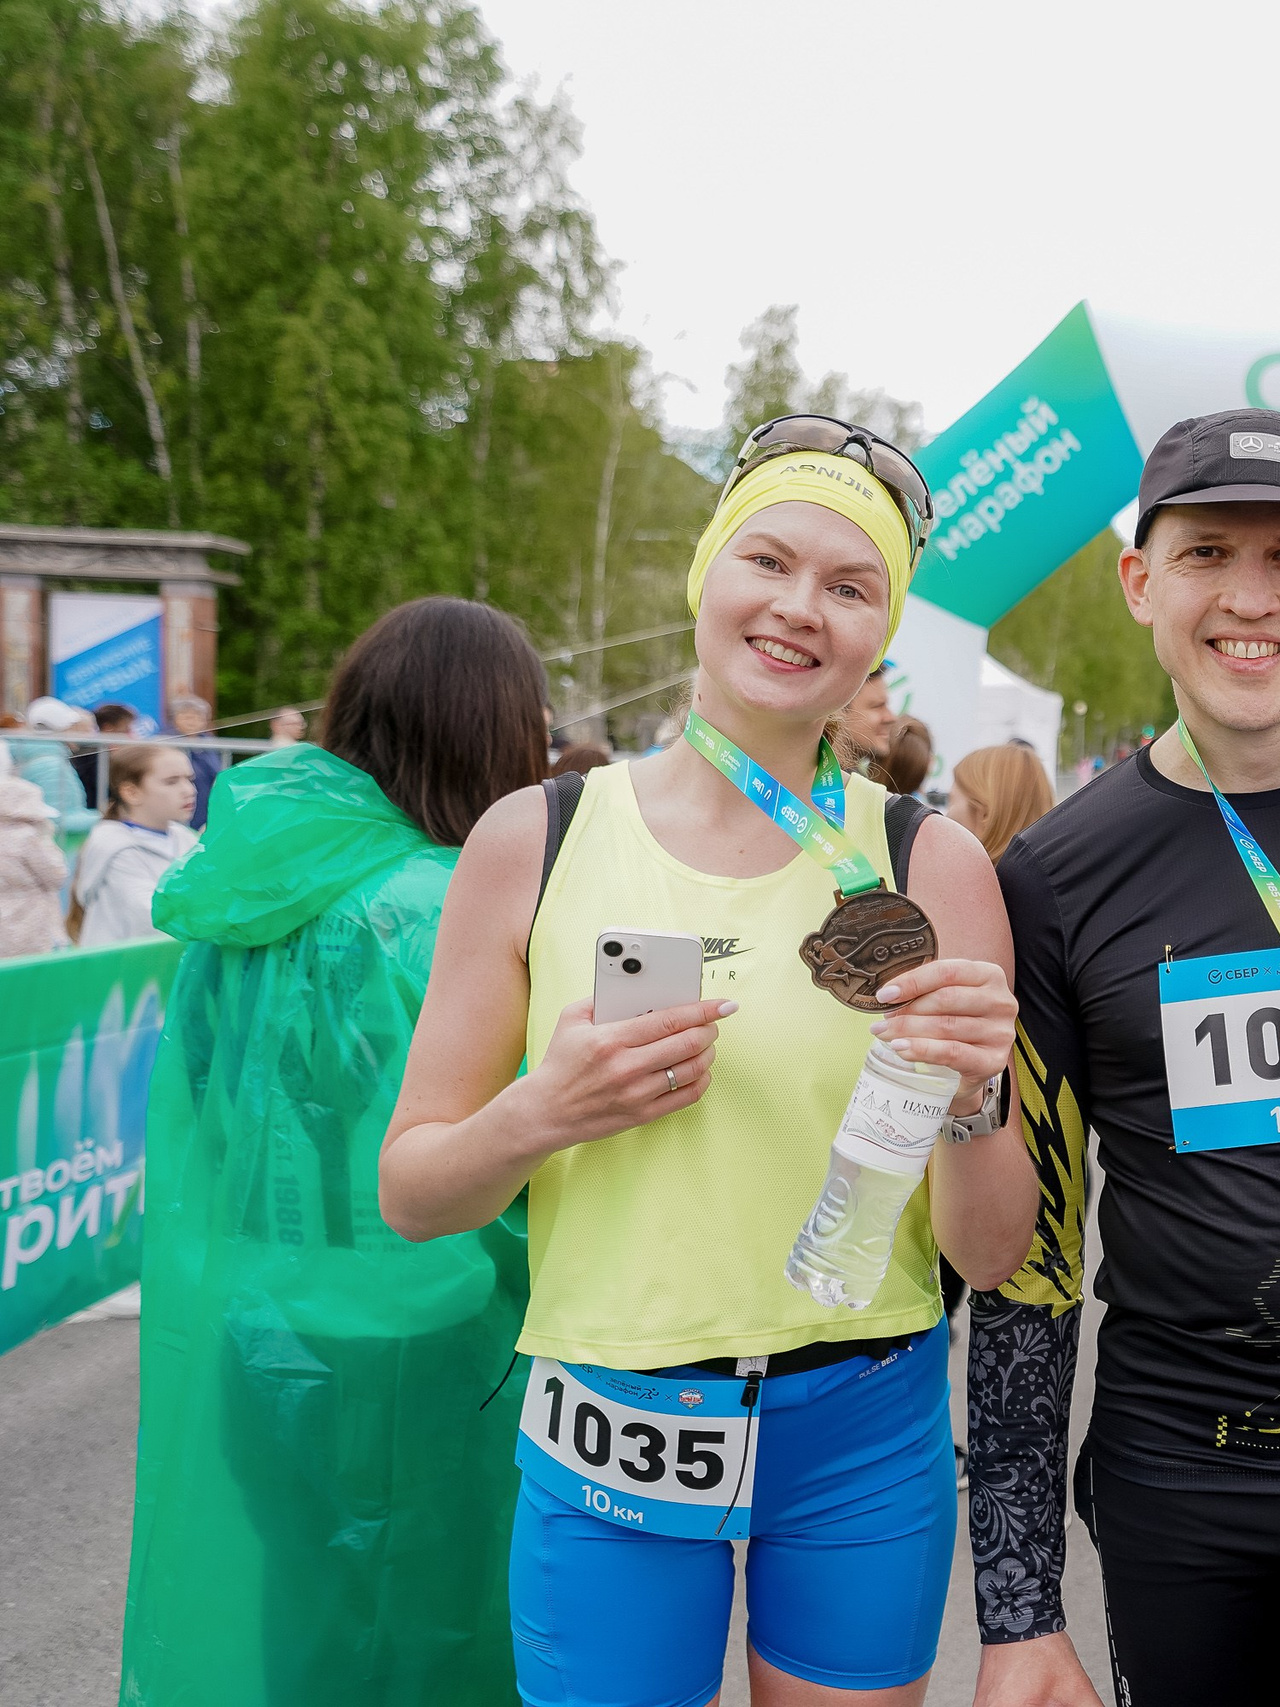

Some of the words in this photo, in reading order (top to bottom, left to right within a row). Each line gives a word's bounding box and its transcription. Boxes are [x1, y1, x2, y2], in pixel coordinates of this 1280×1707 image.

[935, 428, 1082, 560] марафон
[781, 805, 800, 825] СБЕР
[1247, 849, 1268, 873] СБЕР
[1266, 881, 1280, 898] 185
[890, 936, 925, 954] СБЕР
[702, 969, 736, 980] IR
[1225, 968, 1259, 981] СБЕР
[0, 1137, 124, 1211] твоём
[274, 1173, 304, 1247] 1988
[858, 1363, 881, 1380] PULSE
[880, 1352, 899, 1368] BELT
[605, 1381, 639, 1397] марафон
[610, 1377, 642, 1392] зелёный
[544, 1375, 726, 1491] 1035
[582, 1484, 611, 1514] 10
